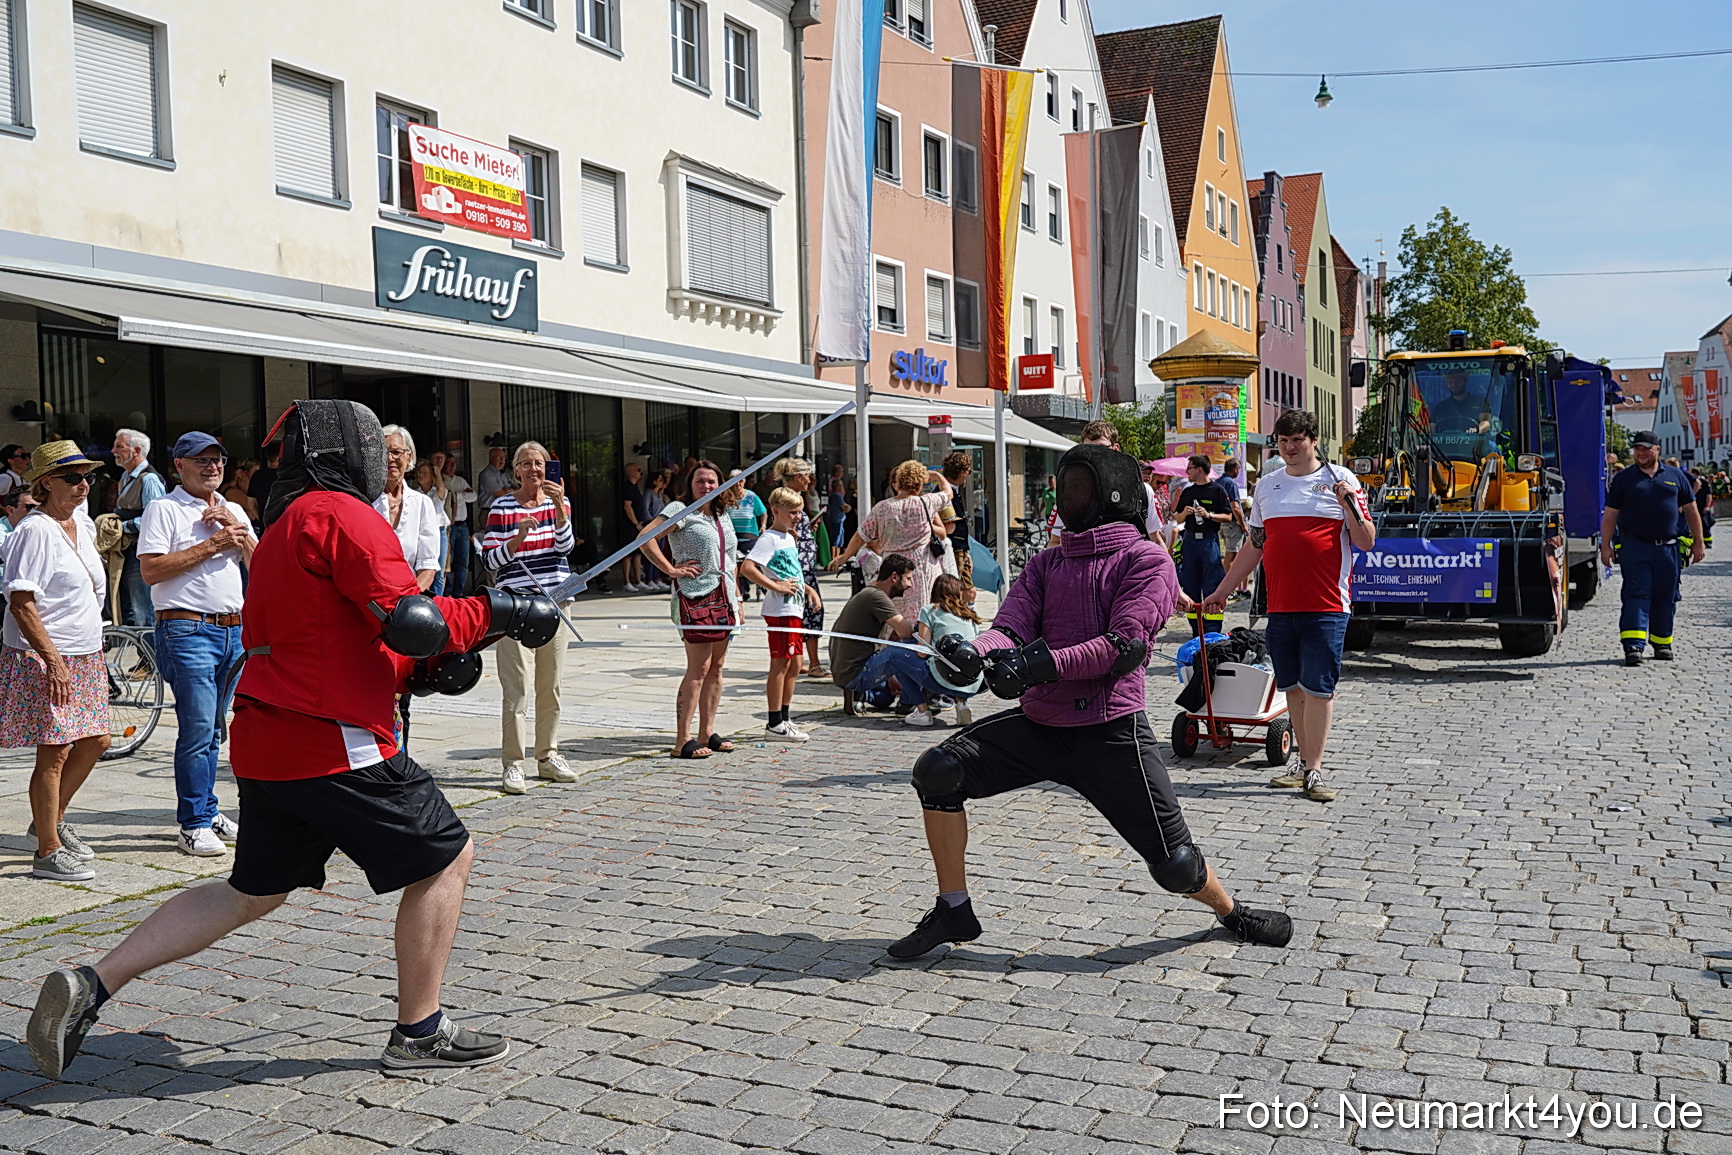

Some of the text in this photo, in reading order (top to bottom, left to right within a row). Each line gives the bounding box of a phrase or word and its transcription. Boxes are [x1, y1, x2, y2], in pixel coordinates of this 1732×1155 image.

[415, 135, 520, 181] Suche Mieter!
[464, 199, 526, 221] raetzer-immobilien.de
[465, 209, 488, 225] 09181
[495, 216, 511, 229] 509
[511, 220, 528, 233] 390
[893, 347, 949, 387] sutor
[1022, 365, 1048, 376] WITT
[1426, 361, 1481, 371] VOLVO
[1707, 389, 1719, 417] SALE
[1207, 409, 1238, 420] VOLKSFEST
[1445, 436, 1471, 445] 86/72
[1365, 551, 1482, 568] Neumarkt
[1357, 589, 1429, 597] www.thw-neumarkt.de
